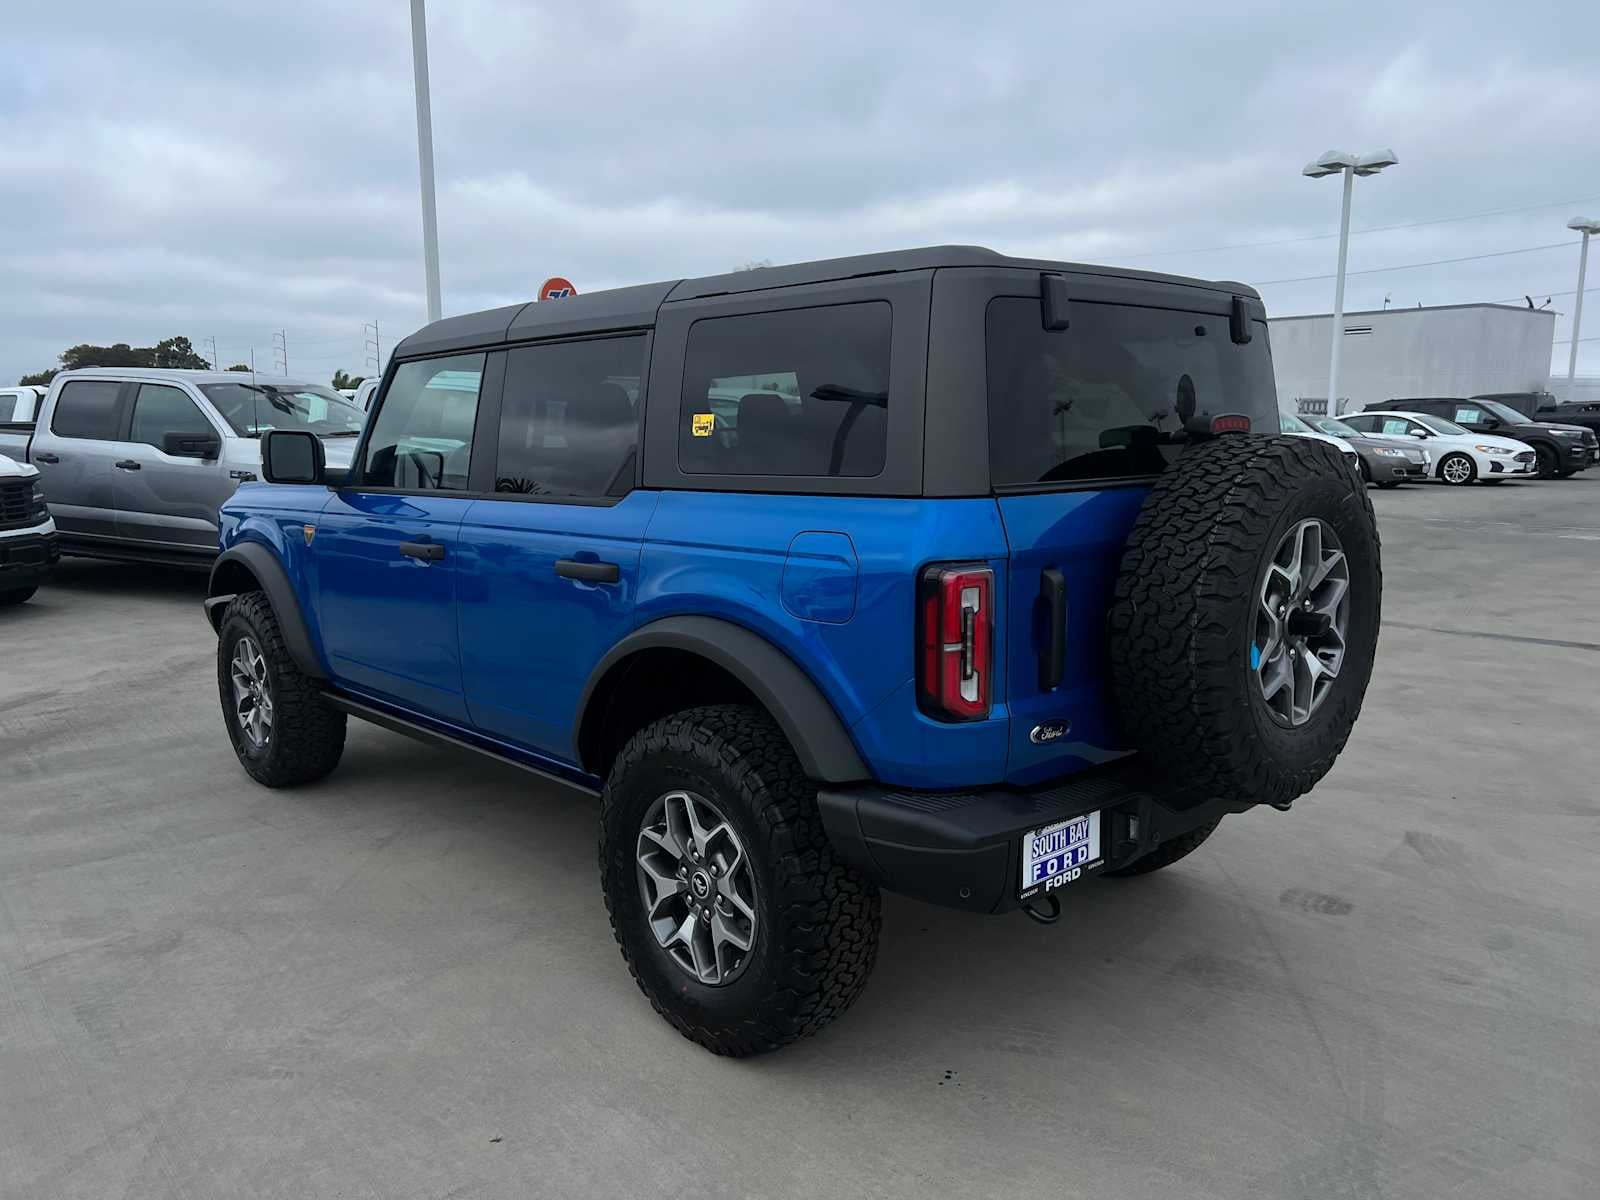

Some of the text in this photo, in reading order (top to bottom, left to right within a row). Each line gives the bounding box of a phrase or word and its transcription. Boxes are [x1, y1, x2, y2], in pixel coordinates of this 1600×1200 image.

[1041, 726, 1063, 740] Ford
[1032, 829, 1067, 858] SOUTH
[1069, 820, 1089, 844] BAY
[1033, 845, 1088, 881] FORD
[1045, 867, 1081, 892] FORD
